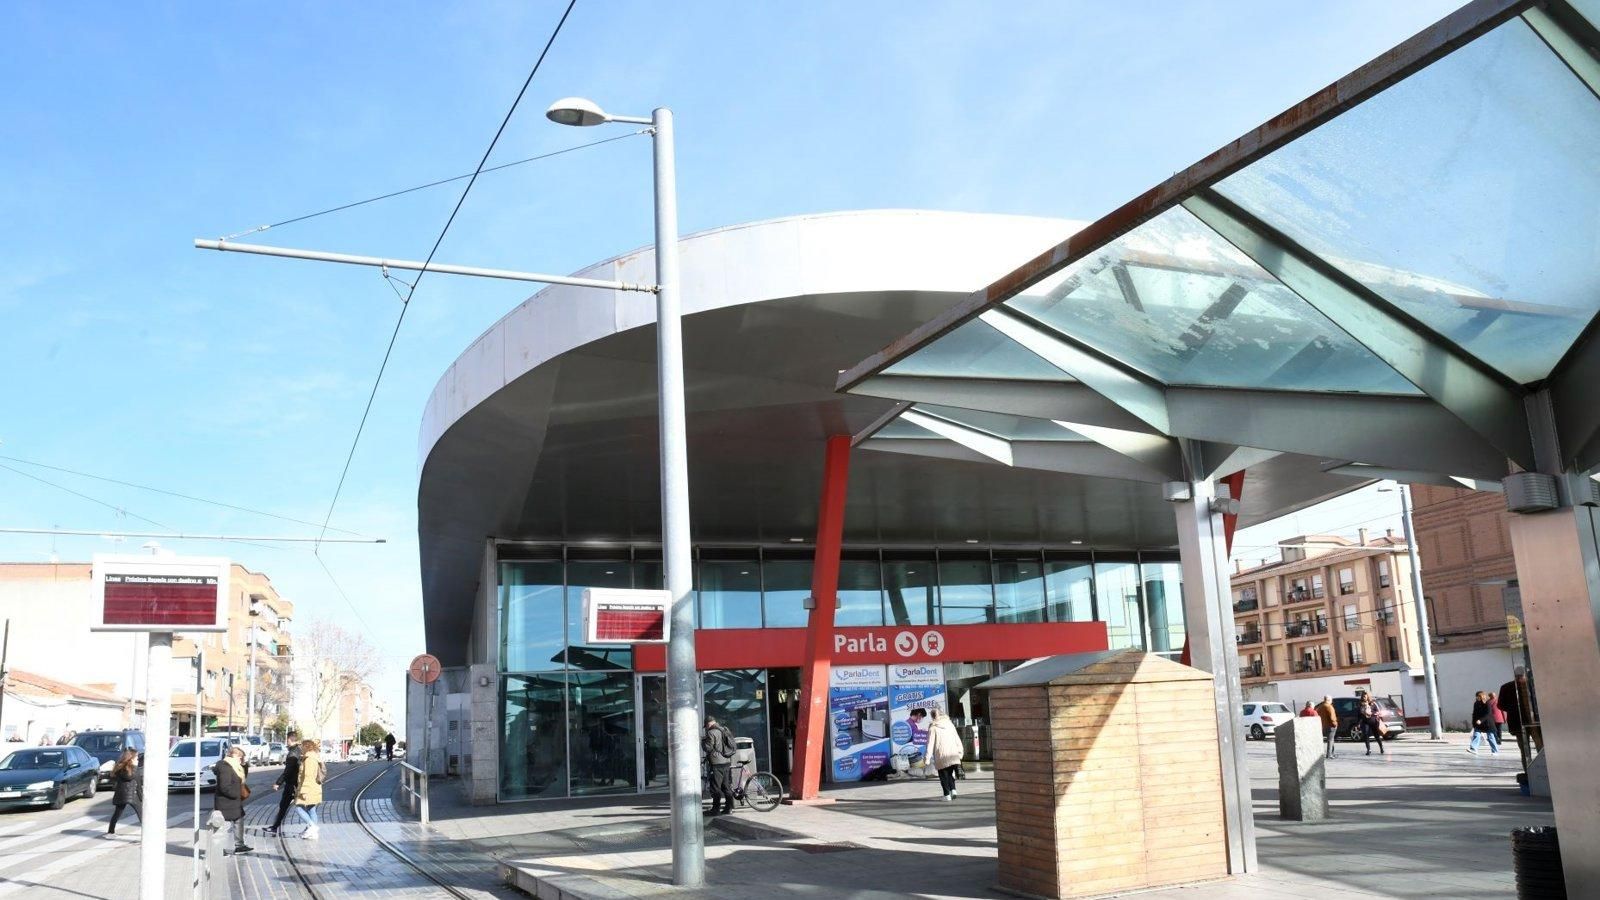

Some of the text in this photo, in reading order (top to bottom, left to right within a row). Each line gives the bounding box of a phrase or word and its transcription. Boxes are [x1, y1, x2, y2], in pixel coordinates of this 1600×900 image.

[834, 633, 887, 653] Parla
[843, 669, 880, 678] ParlaDent
[902, 667, 937, 677] ParlaDent
